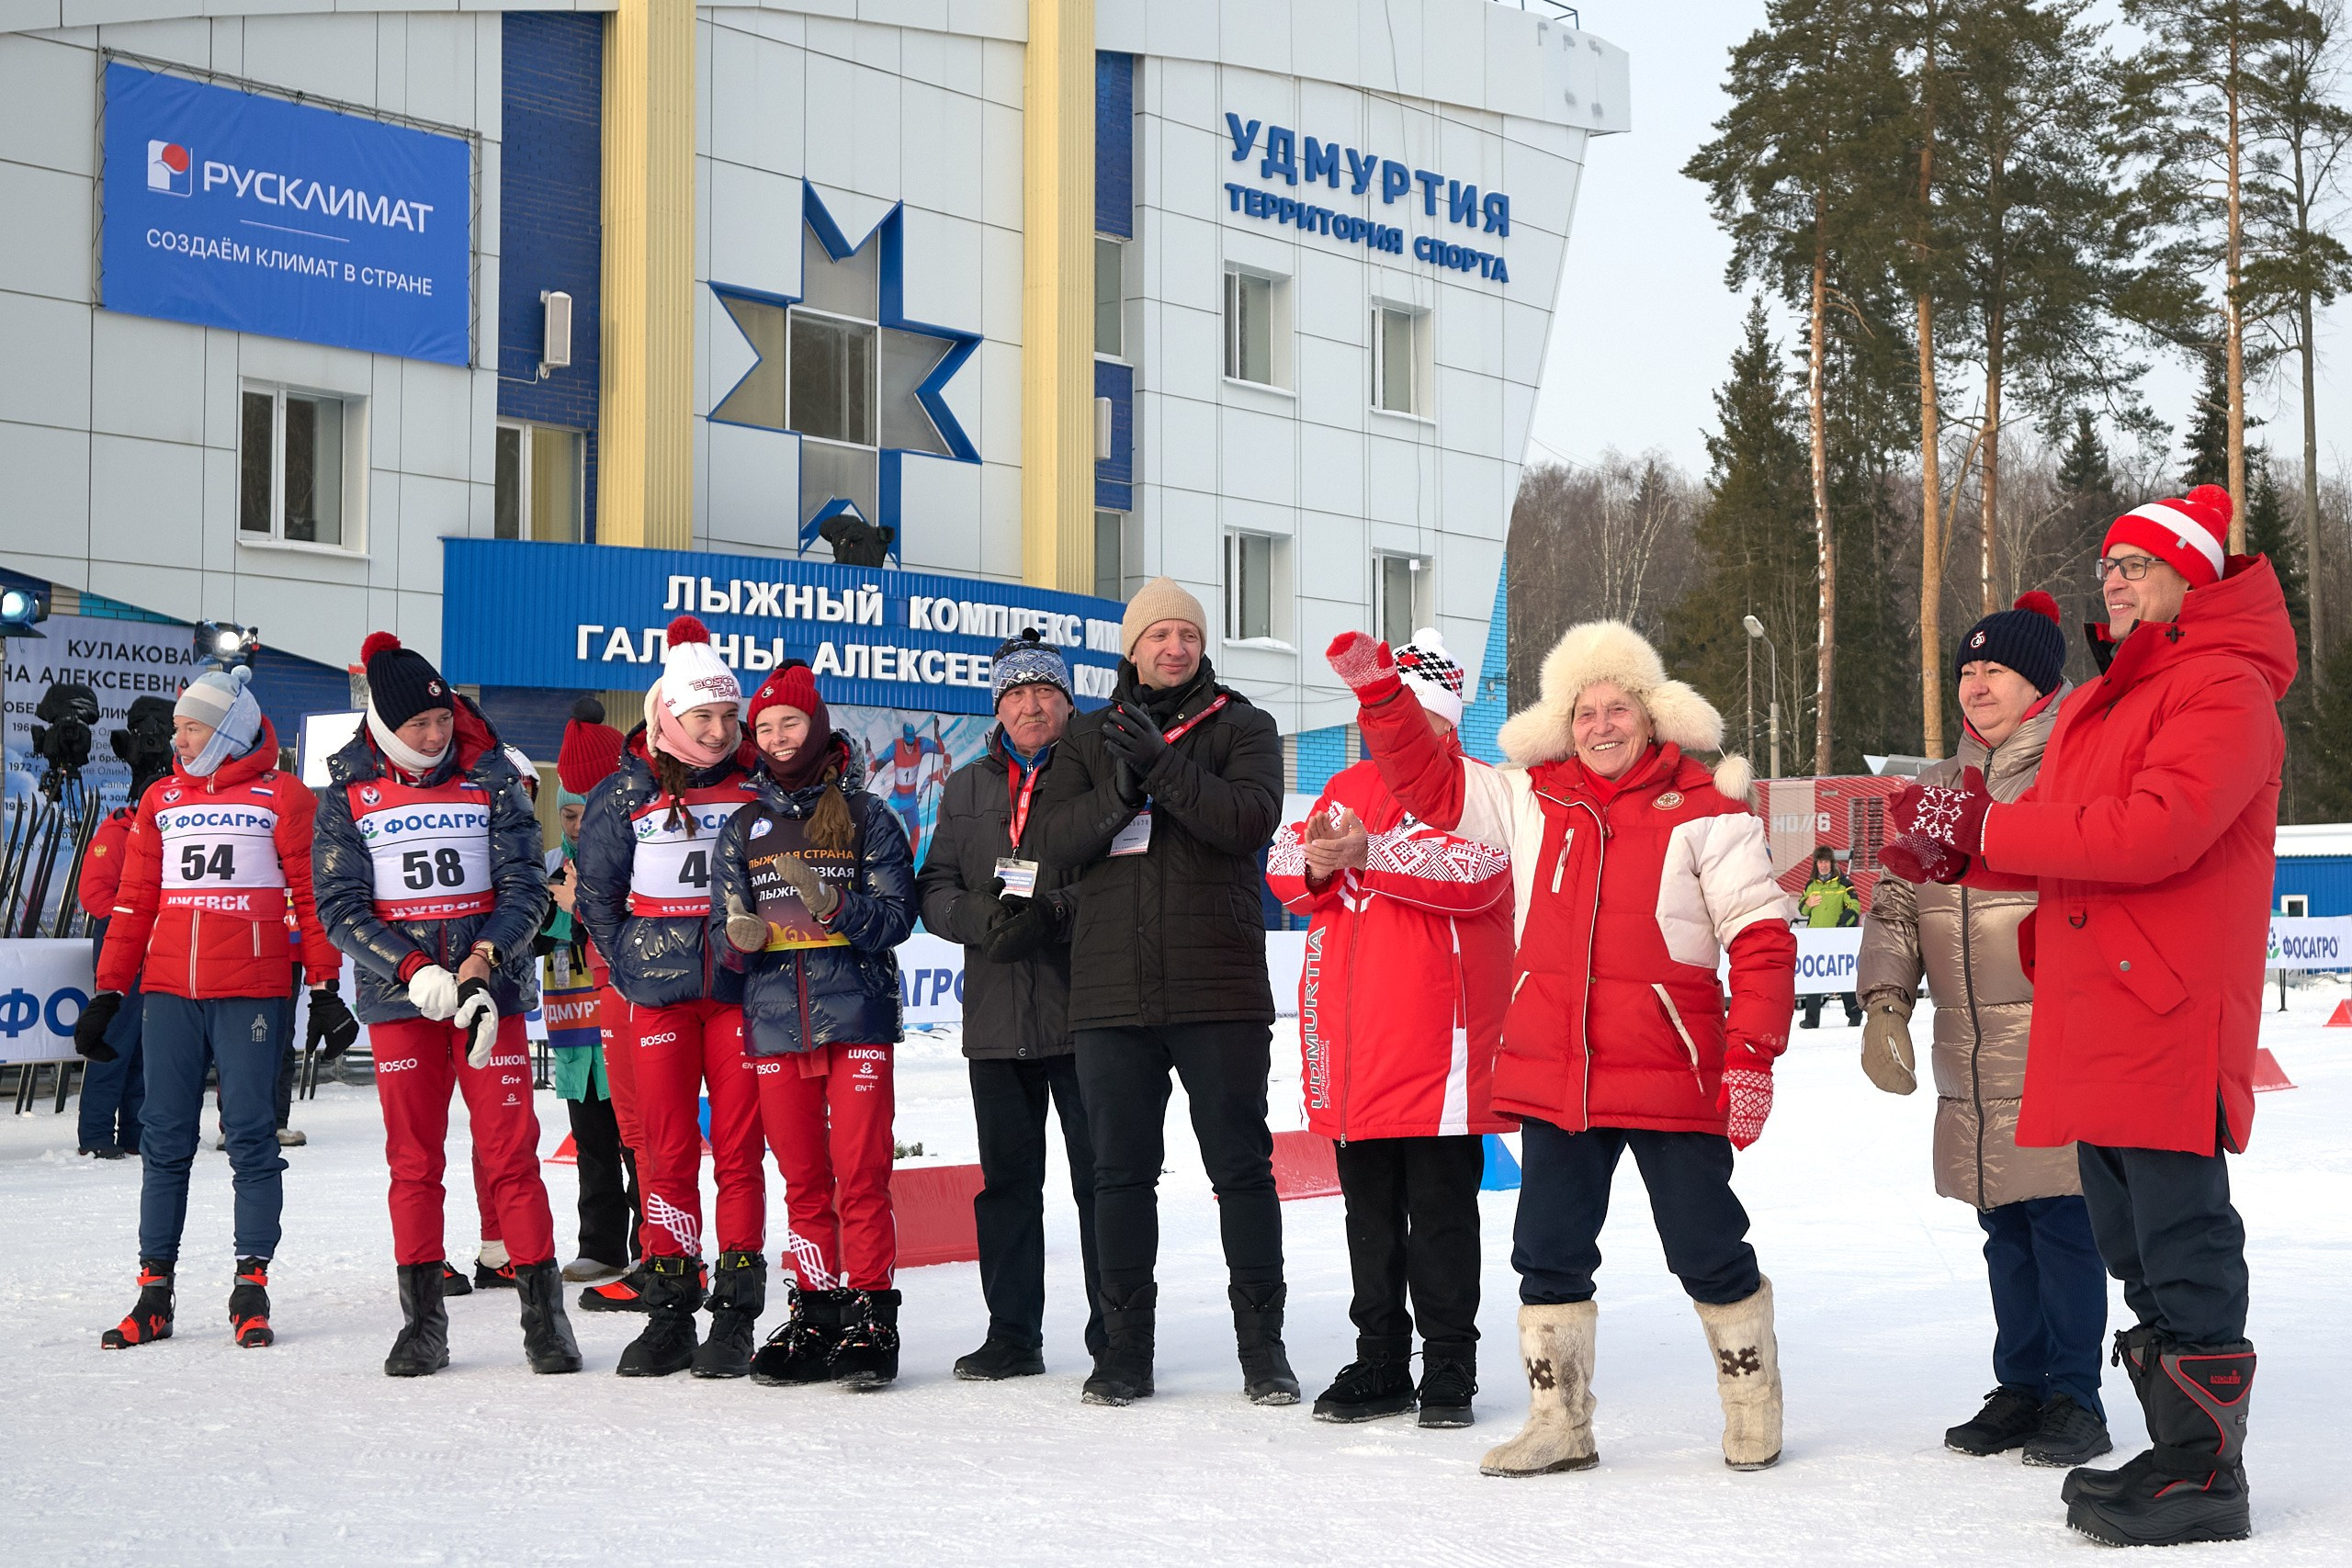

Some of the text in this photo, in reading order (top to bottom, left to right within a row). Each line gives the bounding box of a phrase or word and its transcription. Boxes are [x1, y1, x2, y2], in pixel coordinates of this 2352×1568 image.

[1225, 111, 1510, 237] УДМУРТИЯ
[203, 160, 434, 233] РУСКЛИМАТ
[1224, 182, 1510, 283] ТЕРРИТОРИЯ СПОРТА
[146, 227, 433, 296] СОЗДАЁМ КЛИМАТ В СТРАНЕ
[662, 574, 884, 626] ЛЫЖНЫЙ
[909, 595, 1082, 648] КОМПЛЕКС
[68, 638, 193, 666] КУЛАКОВА
[577, 624, 785, 671] ГАЛНЫ
[812, 641, 993, 688] АЛЕКСЕЕ
[40, 666, 189, 693] АЛЕКСЕЕВНА
[688, 675, 735, 691] BOSCO
[9, 762, 31, 772] 1972
[175, 813, 272, 829] ФОСАГРО
[384, 814, 489, 833] ФОСАГРО
[181, 844, 235, 881] 54
[402, 848, 465, 890] 58
[2282, 935, 2338, 959] ФОСАГРО
[1795, 953, 1860, 977] ОСАГР
[1304, 926, 1327, 1110] UDMURTIA
[640, 1032, 676, 1048] BOSCO
[379, 1057, 417, 1073] BOSCO
[490, 1055, 526, 1066] LUKOIL
[848, 1049, 887, 1061] LUKOIL
